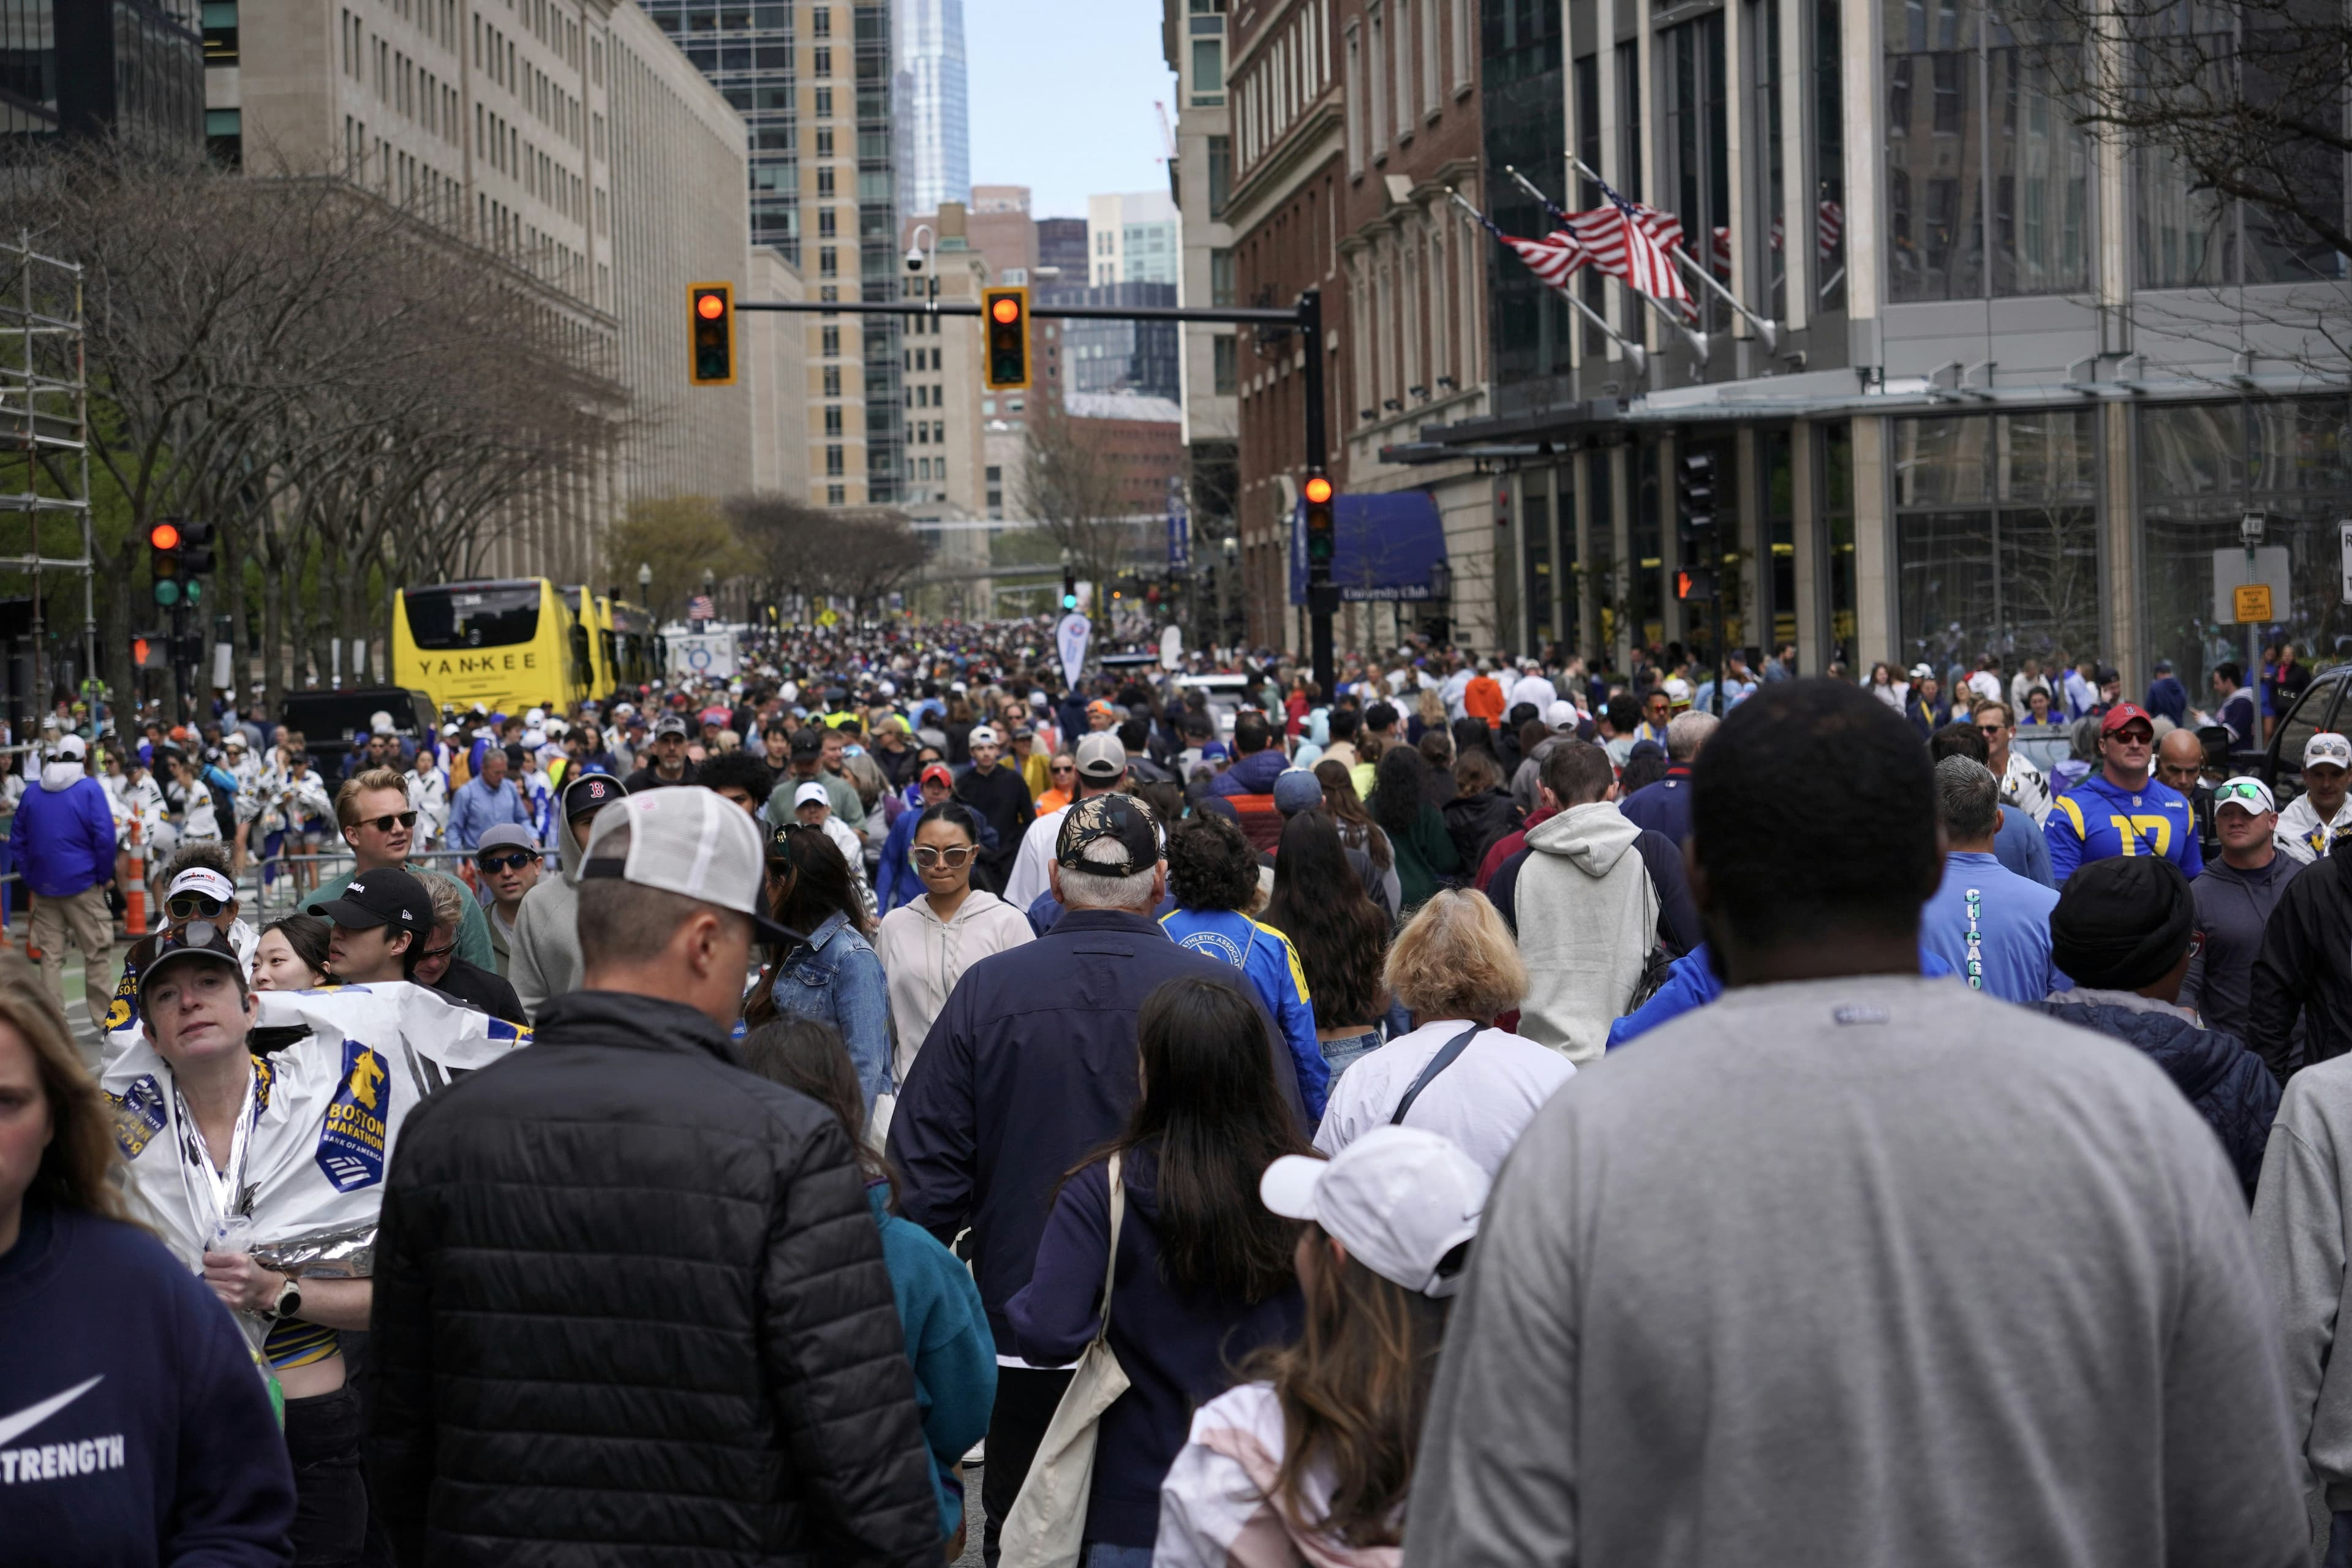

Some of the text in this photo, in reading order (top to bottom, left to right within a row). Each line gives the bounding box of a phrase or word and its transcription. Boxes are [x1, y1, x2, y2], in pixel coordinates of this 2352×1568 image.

[1401, 584, 1428, 598] Club
[589, 781, 605, 798] B
[2110, 815, 2171, 857] 17
[326, 1120, 383, 1151] MARATHON
[329, 1103, 385, 1137] BOSTON
[324, 1134, 383, 1162] BANK OF AMERICA
[0, 1434, 125, 1485] TRENGTH
